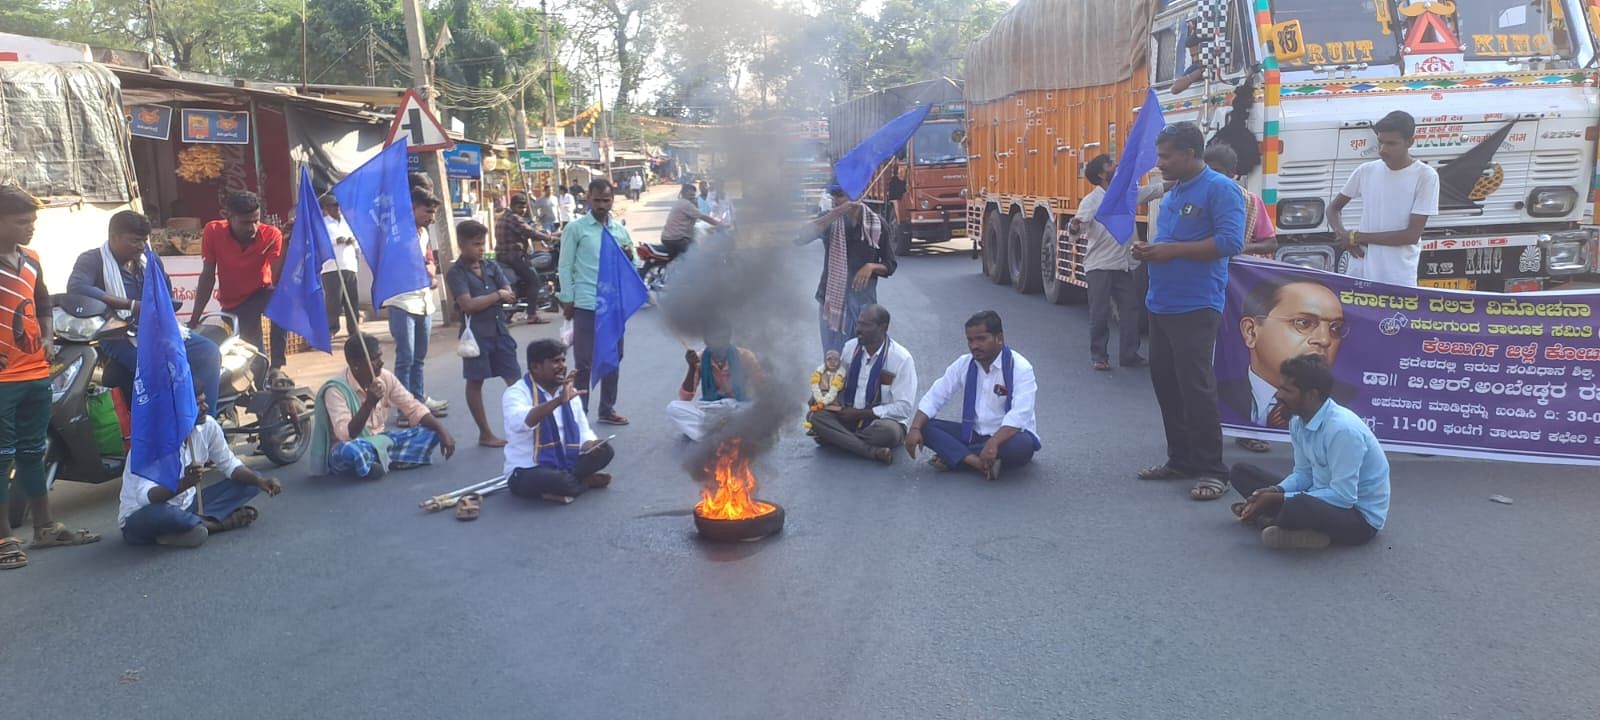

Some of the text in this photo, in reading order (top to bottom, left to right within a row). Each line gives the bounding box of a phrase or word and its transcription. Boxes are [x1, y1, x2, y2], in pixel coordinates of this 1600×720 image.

[1290, 39, 1374, 66] RUIT
[1472, 33, 1553, 56] KING
[1414, 134, 1461, 147] TATA
[1465, 246, 1503, 274] KING
[1340, 289, 1592, 318] ಕರ್ನಾಟಕ ದಲಿತ ವಿಮೋಚನಾ
[1410, 317, 1481, 334] ನವಲಗುಂದ
[1551, 323, 1593, 339] ಸಮಿತಿ
[1505, 342, 1538, 364] ಜಿಲ್ಲೆ
[1399, 356, 1457, 374] ಪ್ರದೇಶದಲ್ಲಿ
[1464, 362, 1500, 374] ಇರುವ
[1506, 364, 1567, 377] ಸಂವಿಧಾನ
[1371, 396, 1422, 410] ಅಪಮಾನ
[1428, 401, 1489, 419] ಮಾಡಿದ್ದನ್ನು
[1495, 407, 1537, 419] ಖಂಡಿಸಿ
[1392, 416, 1437, 433] 11-00
[1443, 422, 1483, 436] ಘಂಟೆಗೆ
[1489, 427, 1542, 441] ತಾಲೂಕ
